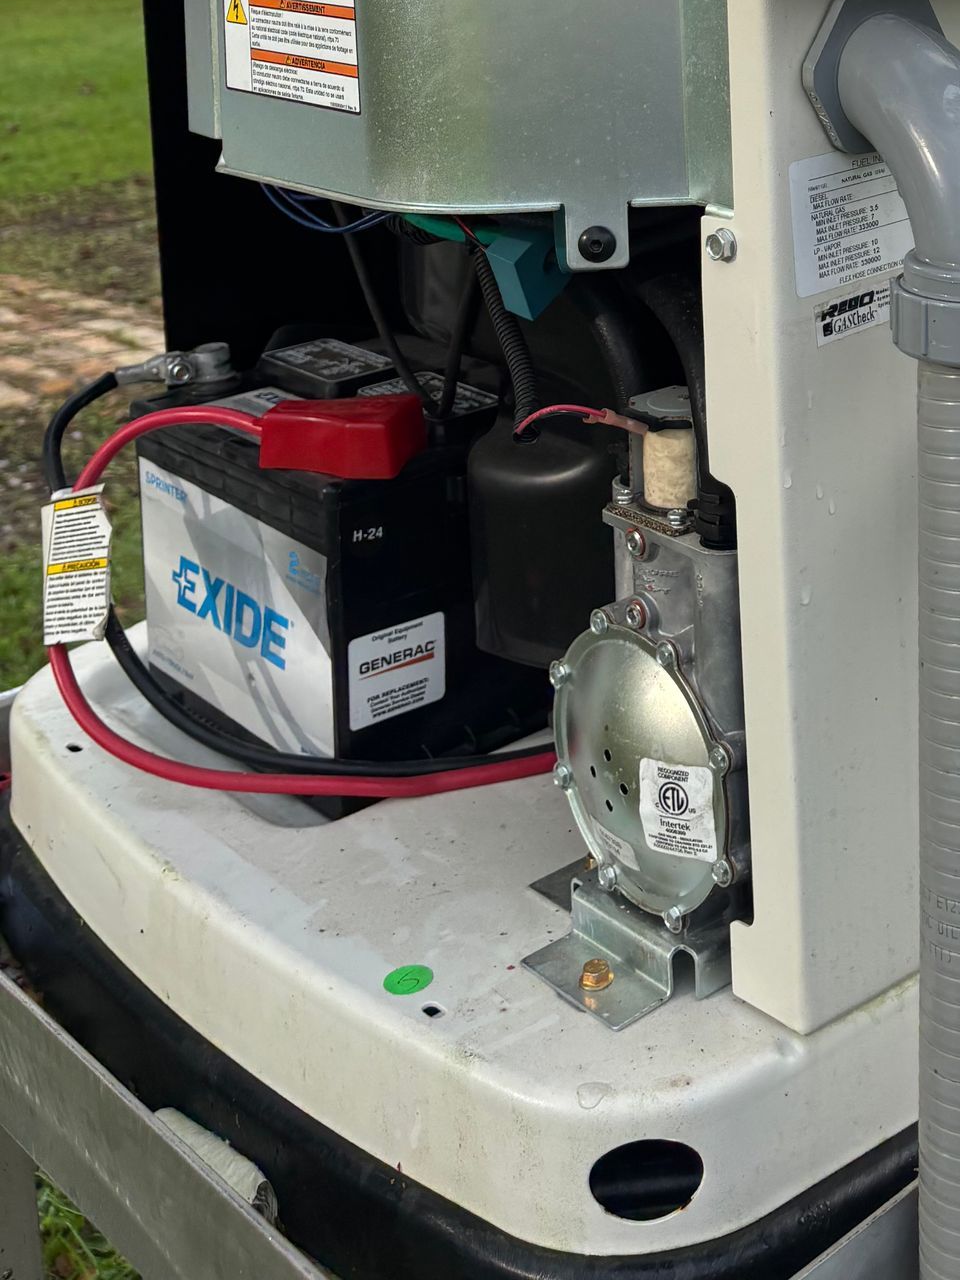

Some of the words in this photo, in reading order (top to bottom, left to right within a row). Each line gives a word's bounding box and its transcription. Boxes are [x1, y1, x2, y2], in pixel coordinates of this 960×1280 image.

[286, 1, 325, 13] AVERTISSEMENT
[292, 57, 325, 69] ADVERTENCIA
[851, 156, 870, 169] FUEL
[841, 173, 861, 183] NATURAL
[862, 170, 872, 178] GAS
[809, 192, 828, 203] DIESEL
[812, 200, 824, 210] MAX
[824, 196, 840, 207] FLOW
[810, 208, 833, 221] NATURAL
[834, 205, 846, 214] GAS
[815, 218, 825, 227] MIN
[825, 214, 840, 224] INLET
[816, 225, 827, 235] MAX
[827, 221, 841, 232] INLET
[816, 233, 827, 242] MAX
[828, 229, 842, 239] FLOW
[813, 247, 820, 255] LP
[823, 241, 841, 252] VAPOR
[817, 253, 827, 262] MIN
[828, 248, 842, 258] INLET
[818, 261, 829, 271] MAX
[829, 256, 843, 267] INLET
[872, 245, 880, 254] 12
[818, 269, 829, 279] MAX
[830, 264, 845, 275] FLOW
[866, 259, 897, 275] CONNECTION
[145, 471, 188, 503] SPRINTER
[353, 526, 383, 542] H-24
[171, 555, 289, 671] EXIDE
[372, 630, 393, 642] Original
[394, 621, 423, 635] Equipment
[387, 632, 407, 645] Battery
[359, 639, 434, 675] GENERAC
[367, 693, 380, 703] FOR
[657, 767, 689, 776] RECOGNIZED
[657, 773, 689, 782] COMPONENT
[660, 819, 690, 831] Intertek
